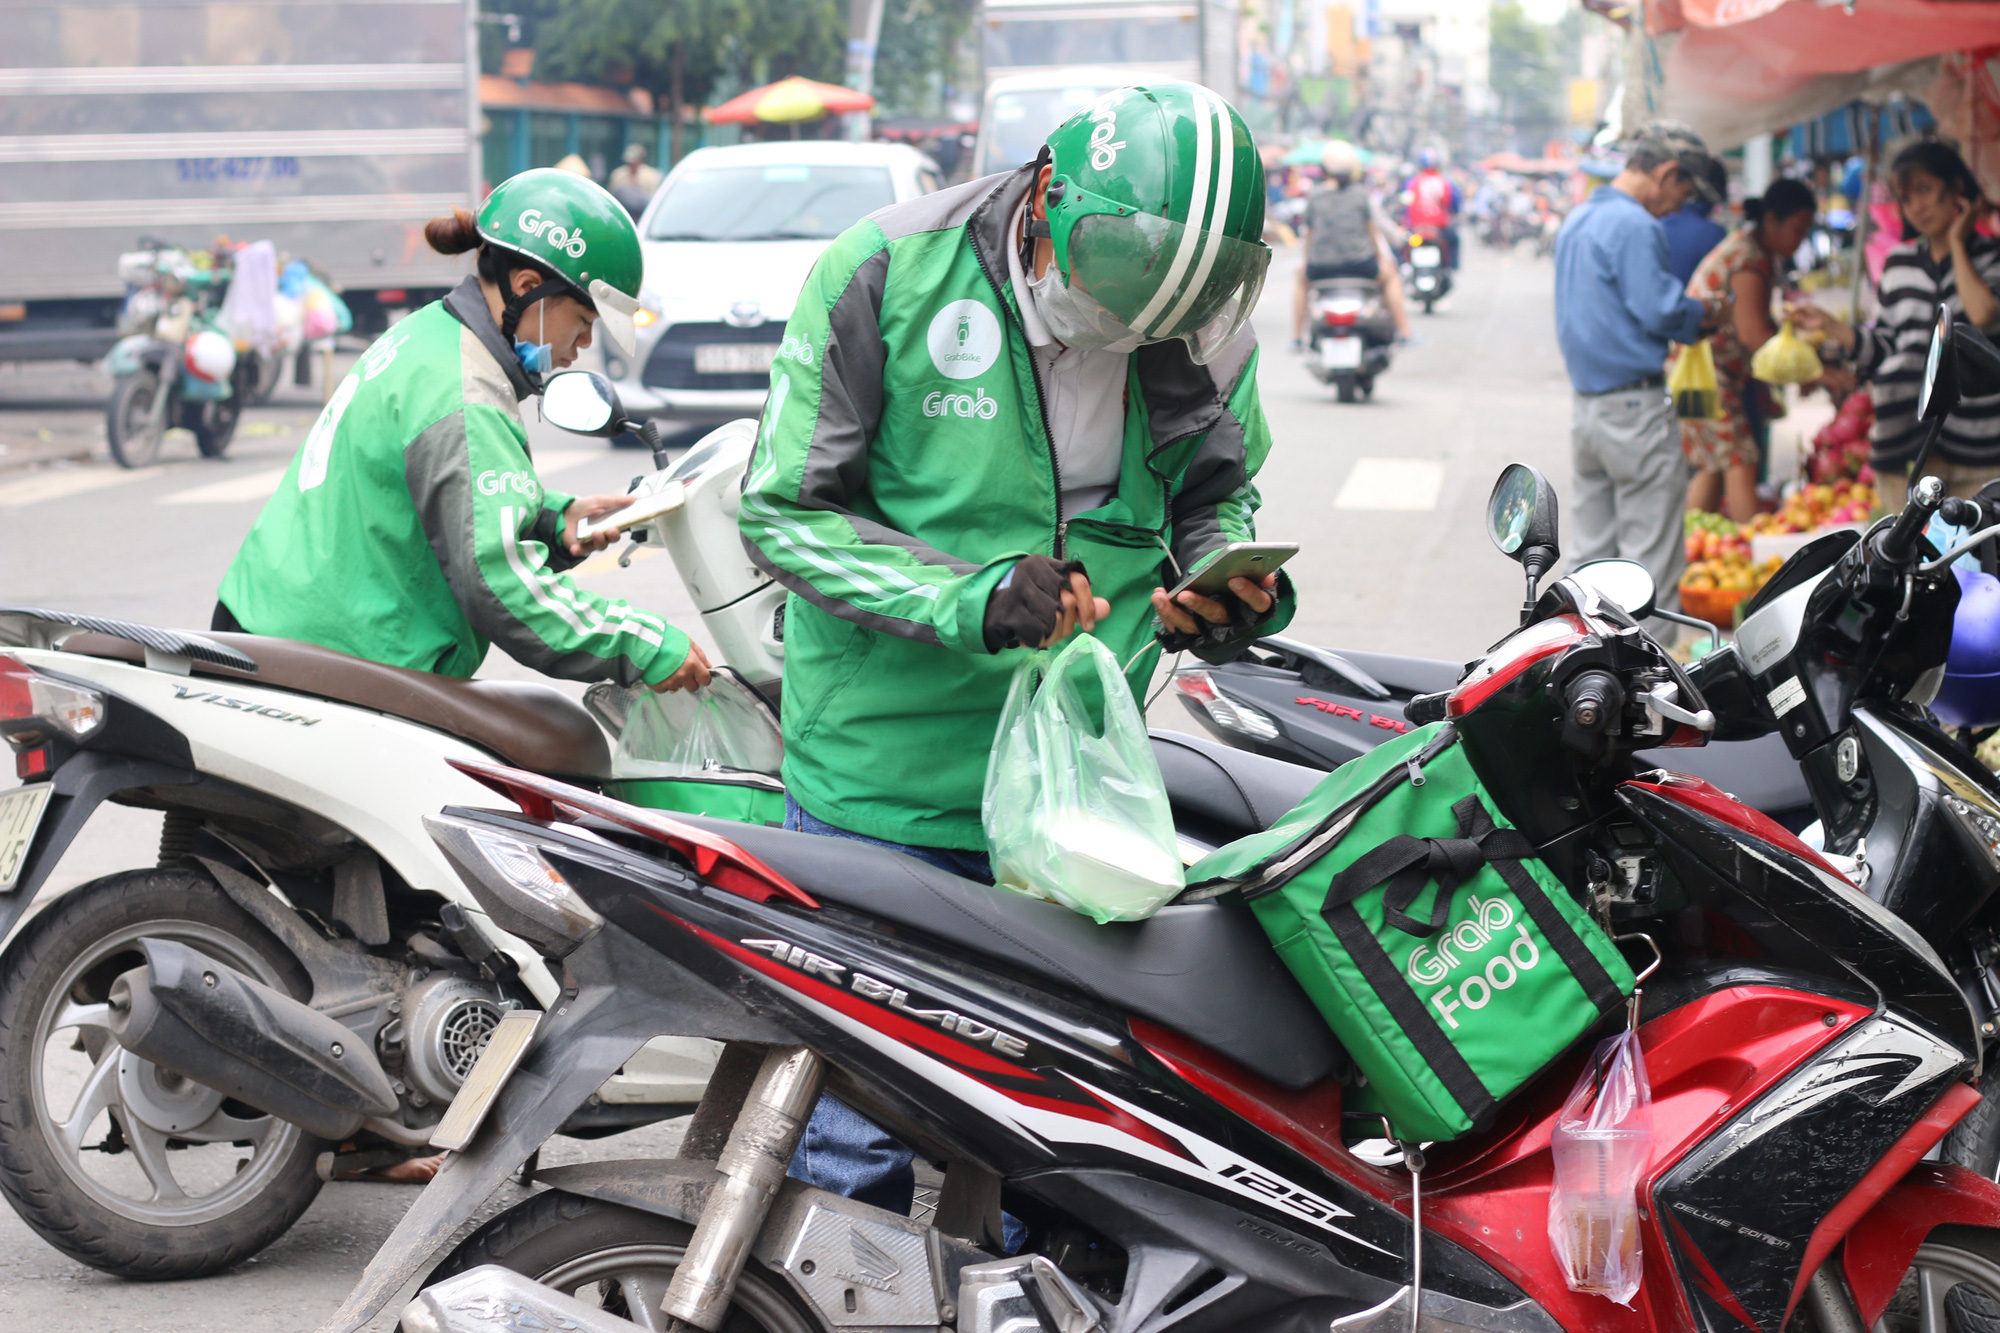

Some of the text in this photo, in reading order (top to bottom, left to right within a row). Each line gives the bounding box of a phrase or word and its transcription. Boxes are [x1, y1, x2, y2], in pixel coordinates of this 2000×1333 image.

[517, 208, 587, 258] Grab
[943, 353, 982, 363] GrabBike
[922, 387, 998, 420] Grab
[172, 684, 322, 726] VISION
[1294, 697, 1364, 721] AIR
[1407, 894, 1514, 986] Grab
[739, 938, 1029, 1058] AIR BLADE
[1430, 922, 1540, 1030] Food
[1217, 1164, 1336, 1220] 125
[832, 1267, 900, 1295] HONDA
